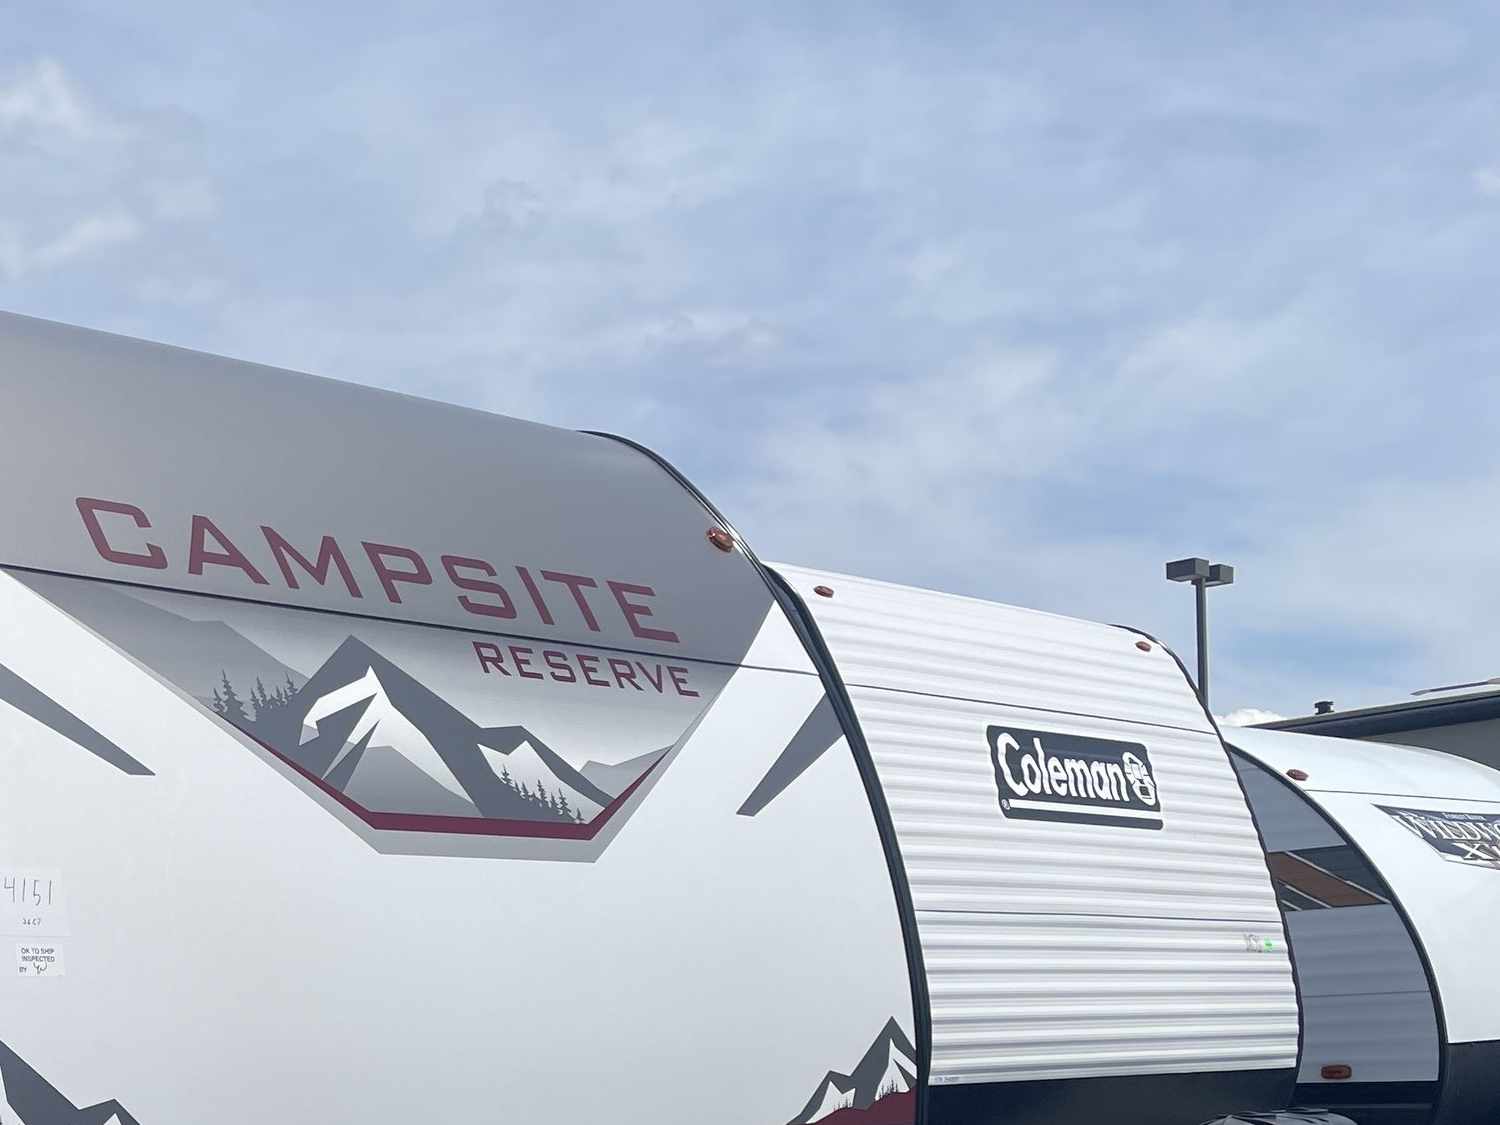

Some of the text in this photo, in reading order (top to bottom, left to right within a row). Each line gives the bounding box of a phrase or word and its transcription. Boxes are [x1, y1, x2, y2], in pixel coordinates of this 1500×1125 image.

[76, 497, 681, 643] CAMPSITE
[472, 641, 700, 697] RESERVE
[996, 732, 1130, 802] Coleman
[3, 877, 52, 906] 4151
